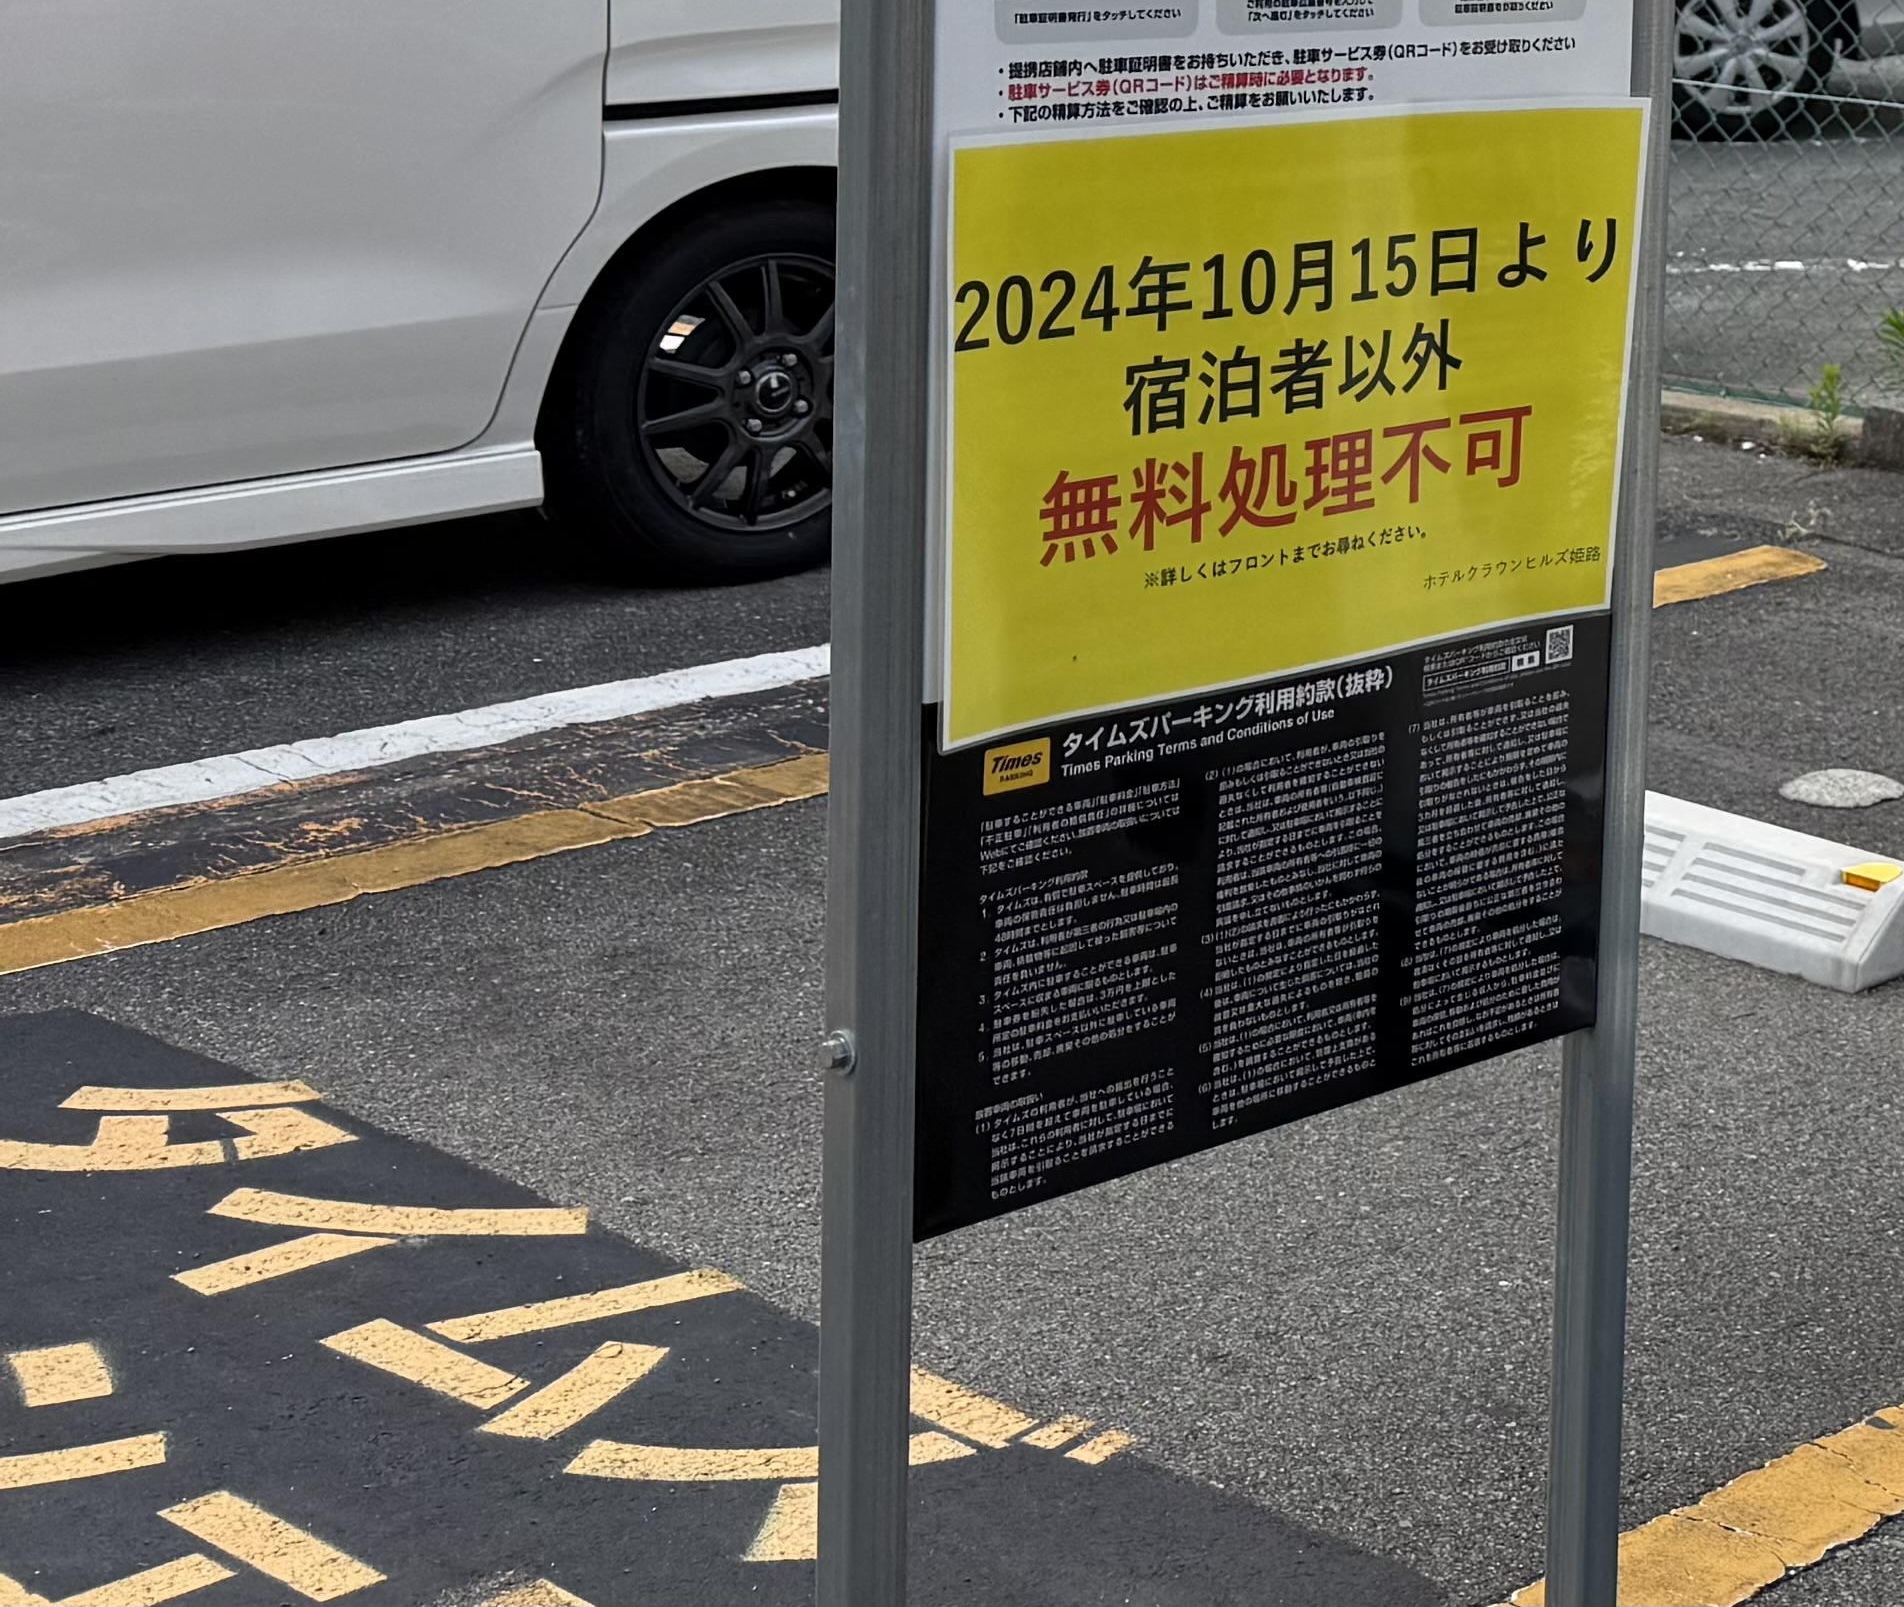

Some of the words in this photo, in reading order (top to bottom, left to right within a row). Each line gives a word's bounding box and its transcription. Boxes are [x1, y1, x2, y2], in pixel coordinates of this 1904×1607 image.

[955, 218, 1619, 352] 2024年10月15日より
[1124, 320, 1462, 437] 宿泊者以外
[1039, 406, 1532, 567] 無料処理不可
[1144, 524, 1428, 590] ※詳しくはフロントまでお尋ねください。
[1423, 545, 1601, 590] ホテルクラウンヒルズ姫路
[1061, 760, 1100, 778] Times
[1105, 747, 1154, 771] Parking
[1158, 739, 1197, 757] Terms
[1200, 730, 1224, 746] and
[1227, 719, 1294, 743] Conditions
[1296, 711, 1309, 726] of
[1311, 707, 1335, 722] Use
[1062, 665, 1394, 758] タイムズパーキング利用約款(抜粋)
[991, 751, 1043, 774] Times
